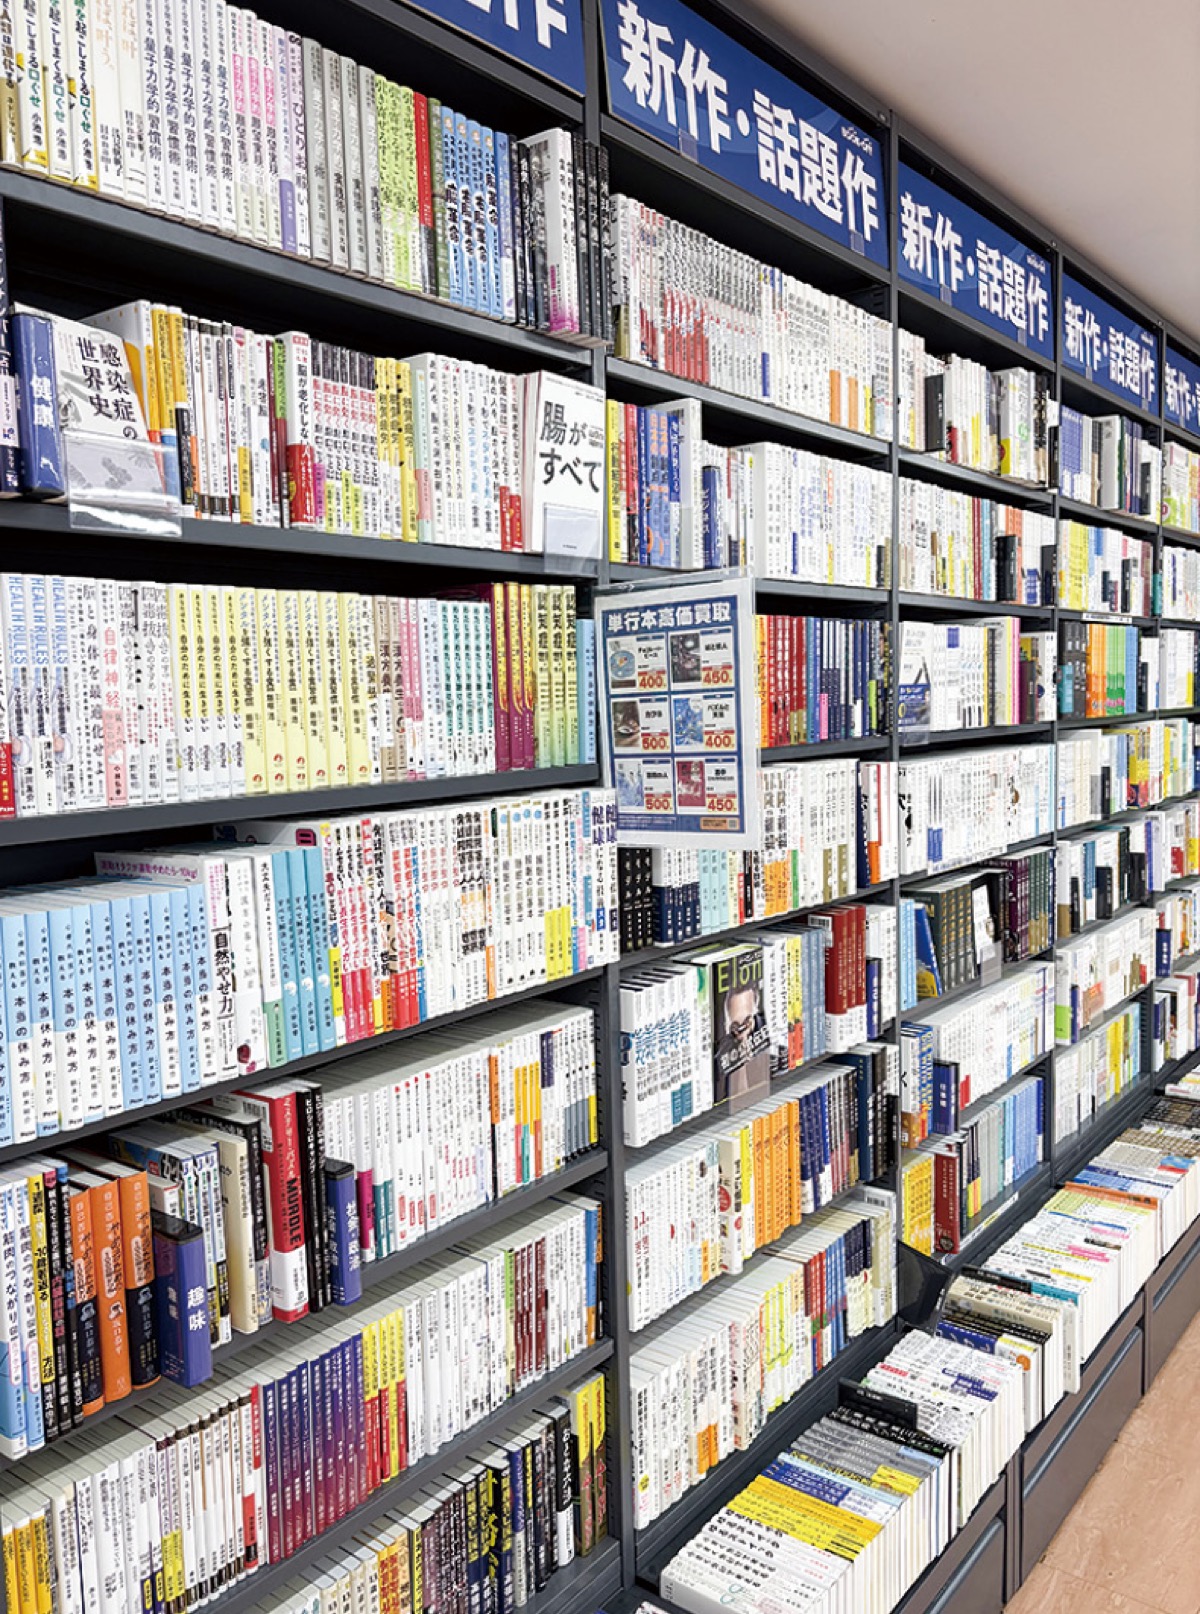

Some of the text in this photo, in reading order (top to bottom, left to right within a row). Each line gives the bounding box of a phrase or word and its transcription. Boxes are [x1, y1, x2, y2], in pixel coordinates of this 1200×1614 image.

[617, 0, 879, 242] 新作・話題作
[901, 191, 1049, 343] 新作・話題作
[76, 335, 113, 419] 世界史
[1063, 296, 1156, 403] 新作・話題作
[100, 341, 138, 439] 感染症の
[540, 399, 588, 446] 腸が
[539, 447, 602, 494] すべて
[9, 577, 28, 664] HEALTH RULES
[30, 578, 50, 664] HEALTH RULES
[52, 578, 69, 664] HEALTH RULES
[608, 602, 731, 633] 単行本高価買取
[103, 627, 120, 708] 自律神経
[639, 673, 667, 689] 400
[703, 670, 732, 684] 450
[642, 737, 669, 750] 500
[705, 735, 735, 748] 400
[645, 799, 673, 811] 500
[708, 798, 737, 811] 450
[123, 974, 138, 1055] 本当の休み方
[142, 970, 155, 1051] 本当の休み方
[162, 966, 175, 1042] 本当の休み方
[182, 961, 195, 1040] 本当の休み方
[198, 956, 212, 1031] 本当の休み方
[717, 956, 762, 994] Elon
[15, 996, 30, 1083] 本当の休み方
[39, 991, 52, 1064] 本当の休み方
[64, 989, 78, 1073] 本当の休み方
[83, 982, 97, 1059] 本当の休み方
[103, 978, 117, 1060] 本当の休み方
